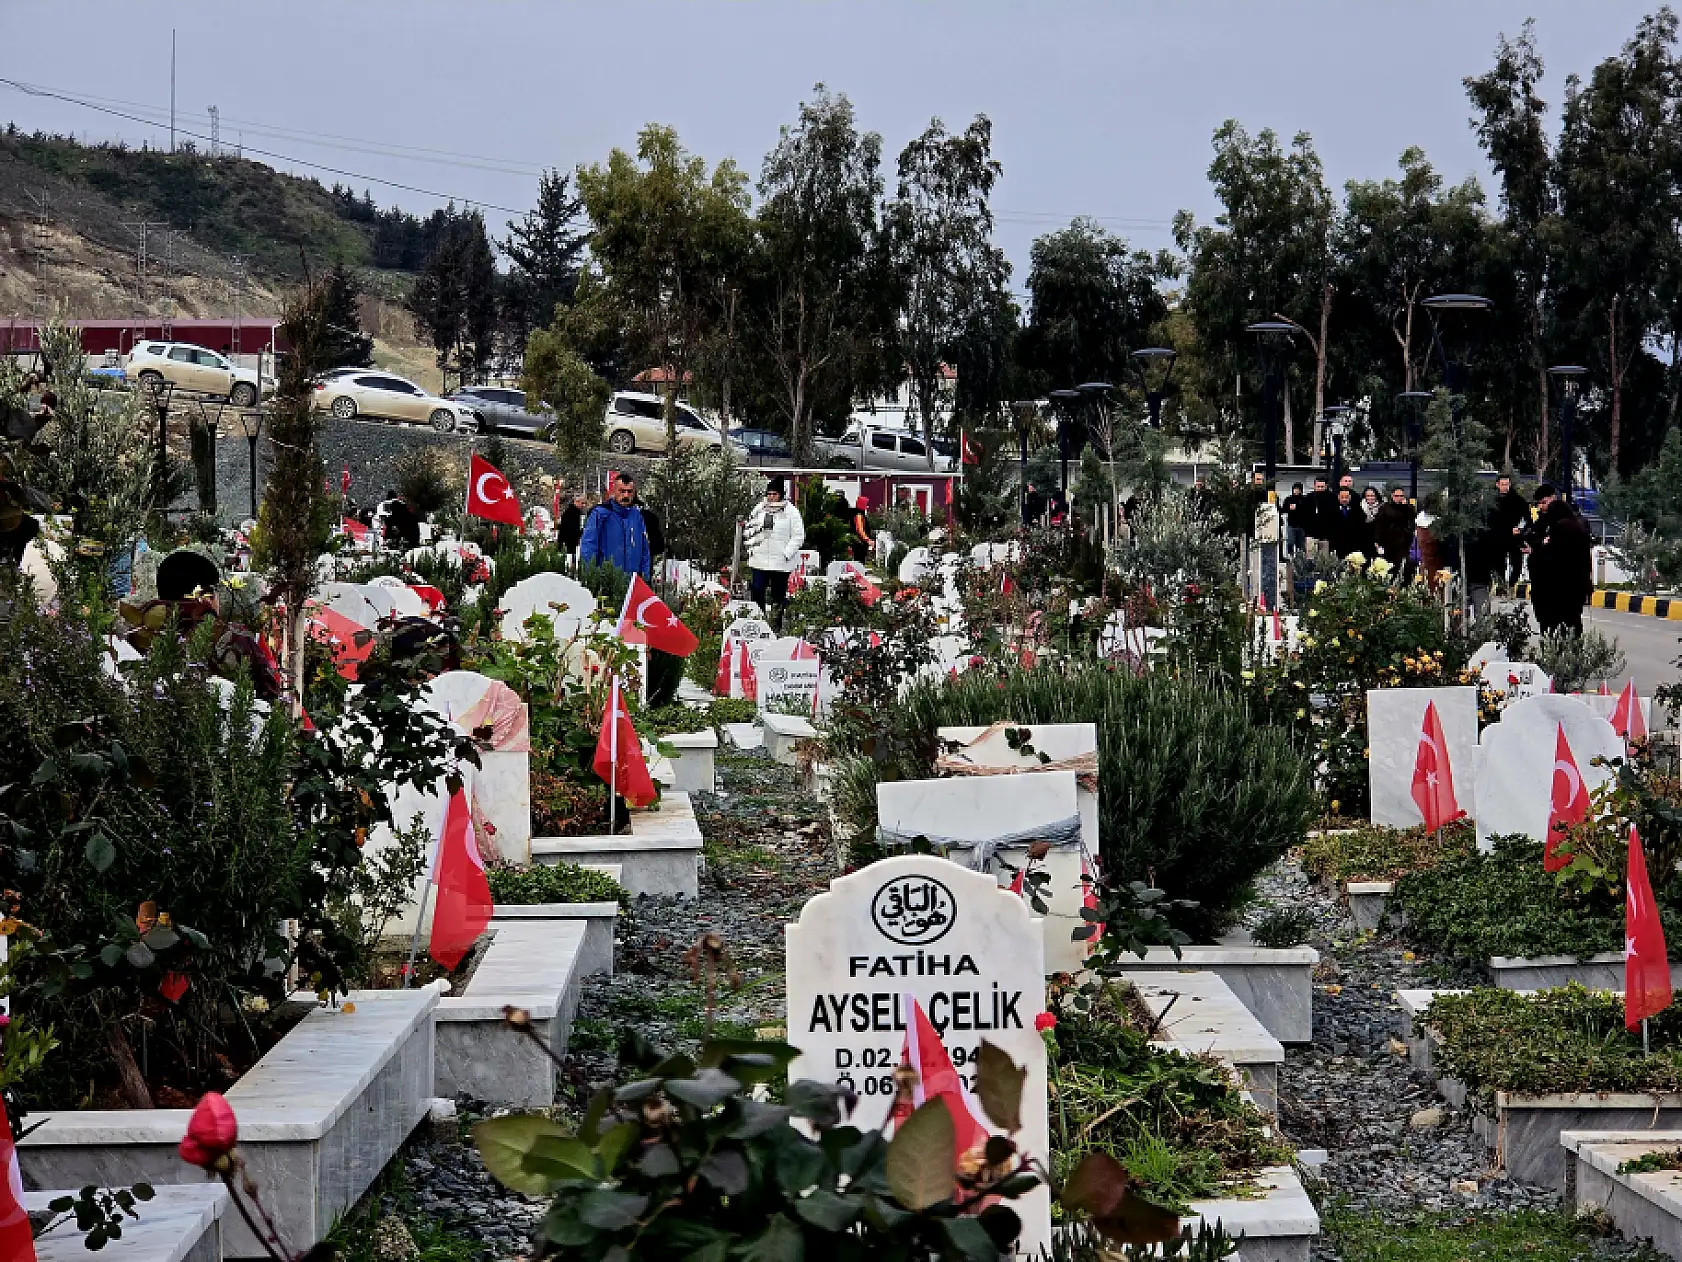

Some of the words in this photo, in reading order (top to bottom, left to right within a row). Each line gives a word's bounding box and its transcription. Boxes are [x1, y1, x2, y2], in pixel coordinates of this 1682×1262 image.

[849, 951, 980, 977] FATİHA
[808, 992, 907, 1033] AYSEL
[928, 982, 1024, 1038] ÇELİK
